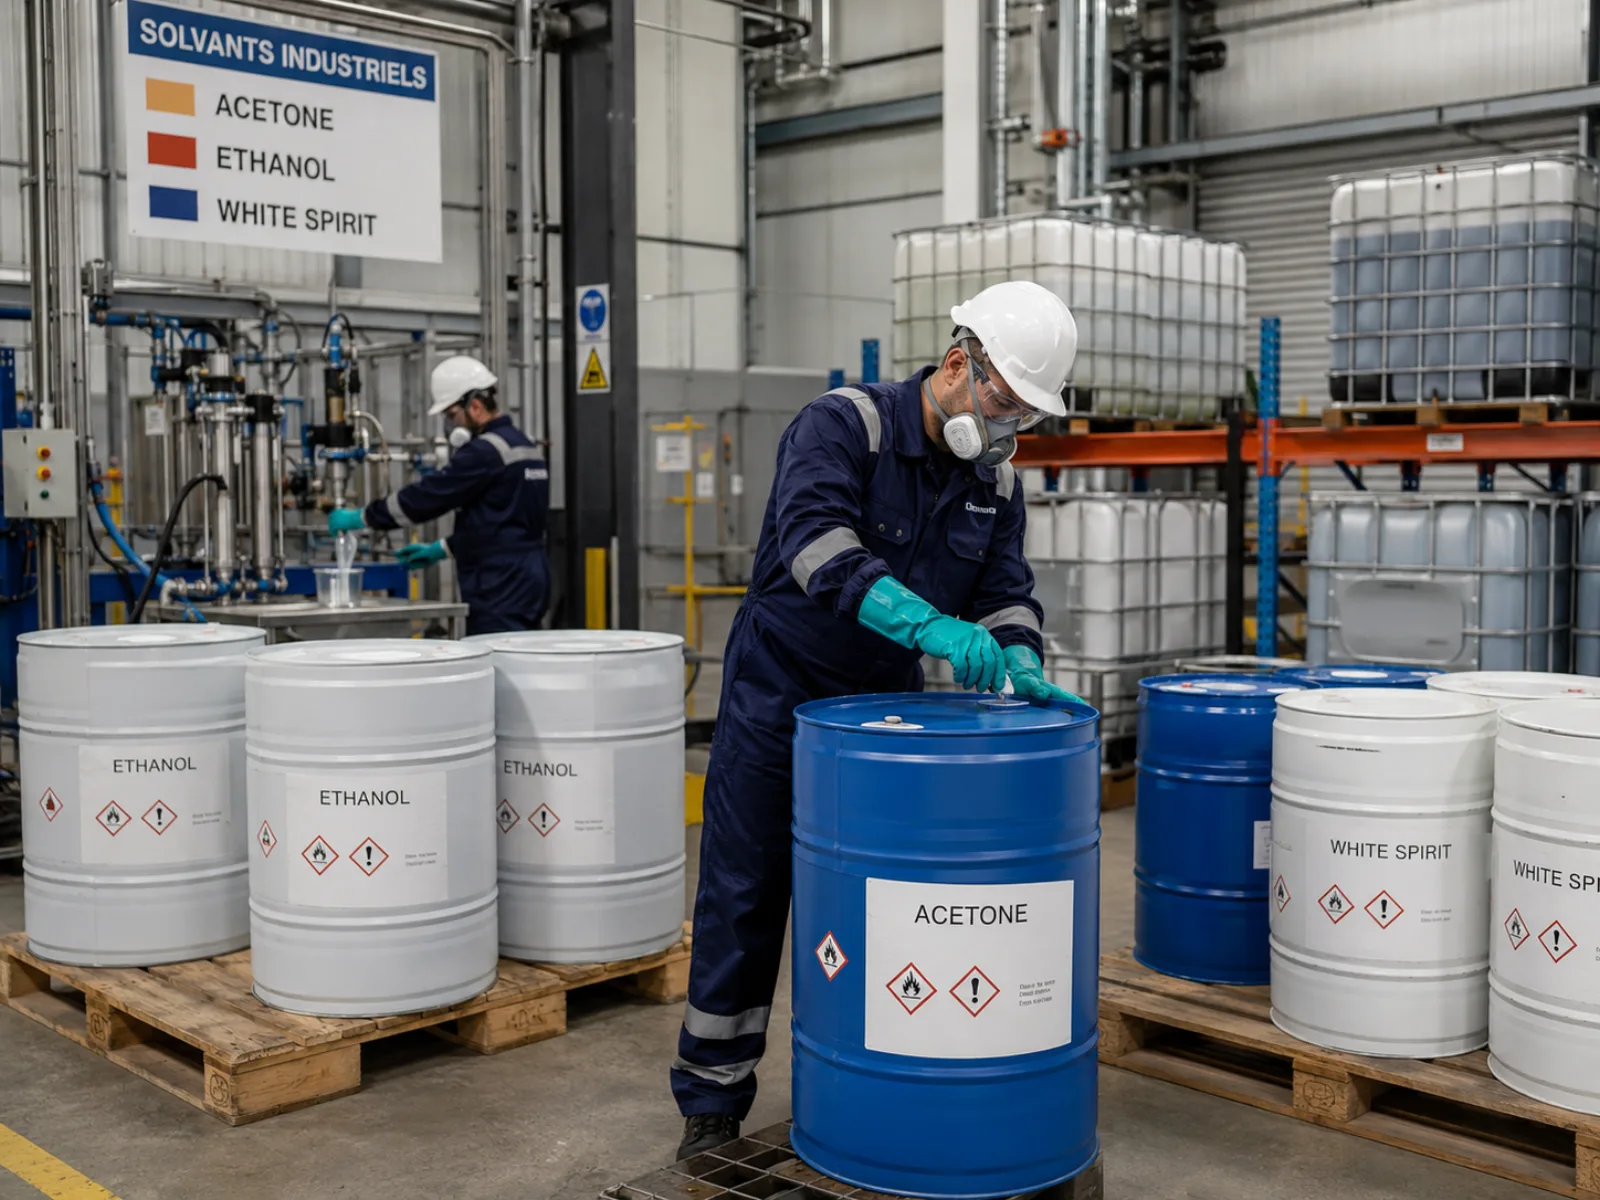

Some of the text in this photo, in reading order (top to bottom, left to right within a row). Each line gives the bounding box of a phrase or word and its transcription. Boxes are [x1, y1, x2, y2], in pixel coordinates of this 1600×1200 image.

[139, 18, 427, 90] SOLVANTS INDUSTRIELS
[215, 93, 334, 131] ACETONE
[216, 146, 336, 182] ETHANOL
[217, 198, 377, 236] WHITE SPIRIT
[113, 756, 197, 774] ETHANOL
[503, 759, 578, 777] ETHANOL
[319, 789, 411, 807] ETHANOL
[1330, 839, 1452, 860] WHITE SPIRIT
[1513, 860, 1563, 887] WHITE
[914, 903, 1028, 926] ACETONE
